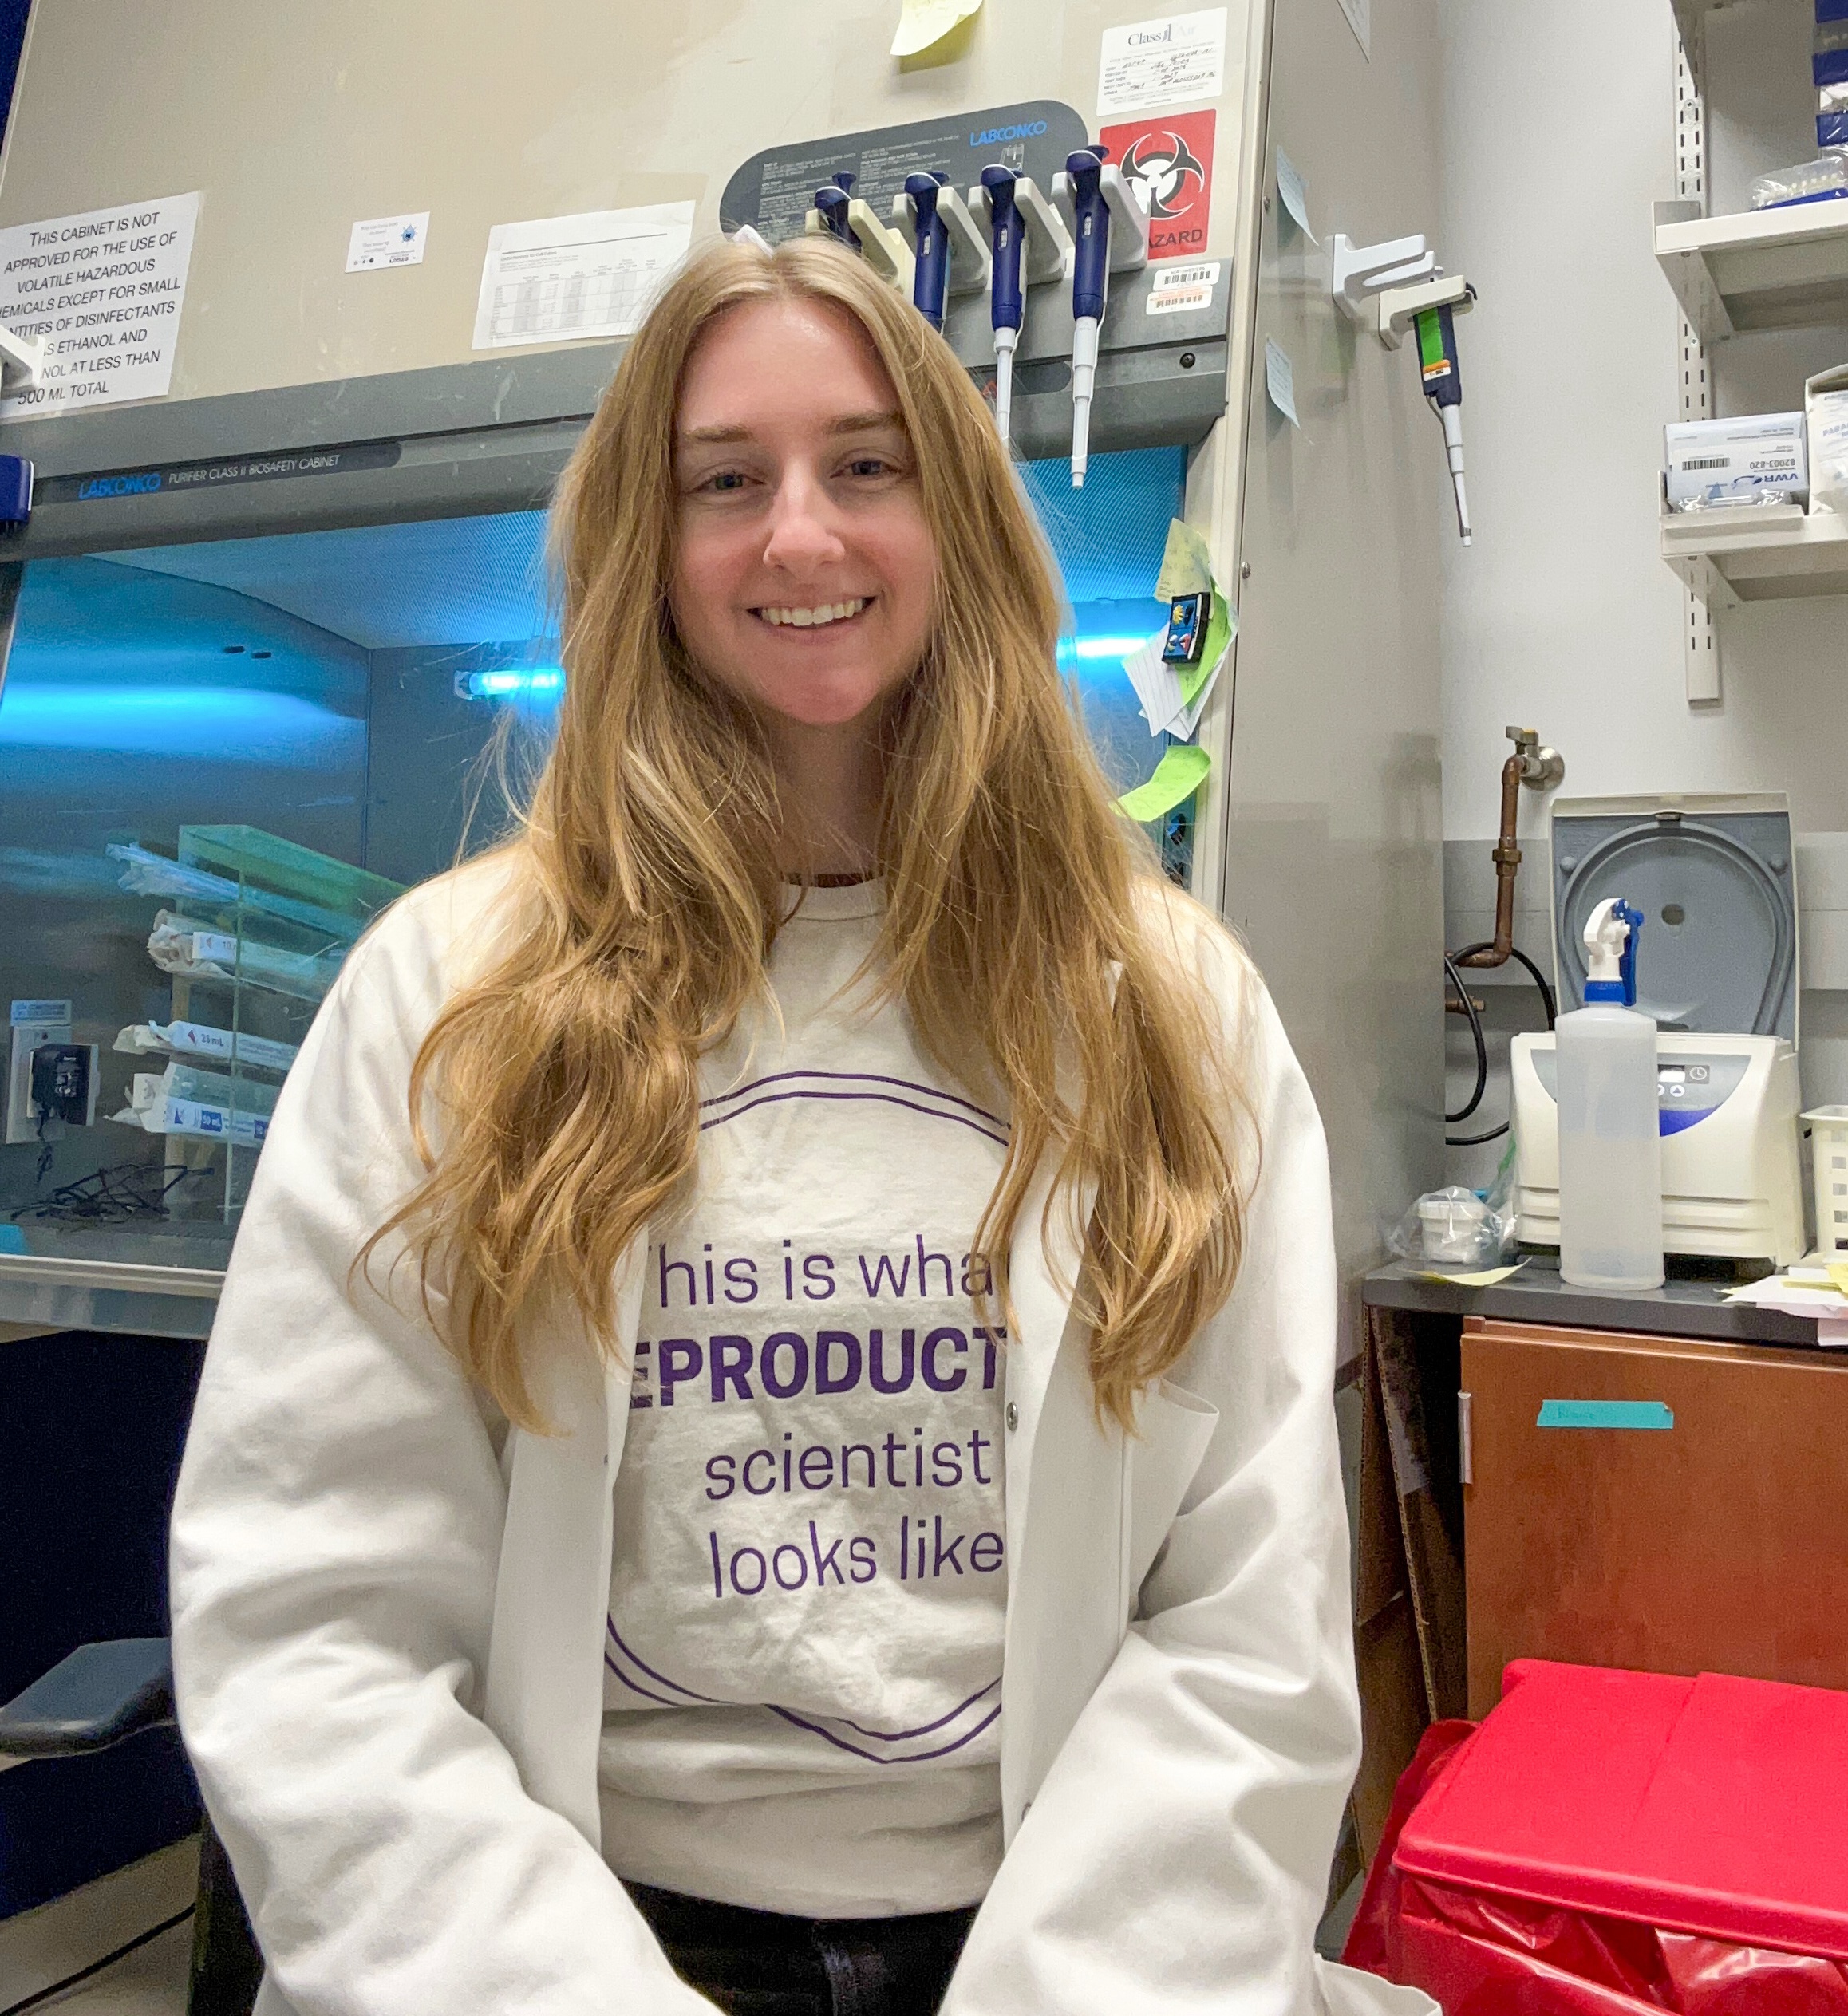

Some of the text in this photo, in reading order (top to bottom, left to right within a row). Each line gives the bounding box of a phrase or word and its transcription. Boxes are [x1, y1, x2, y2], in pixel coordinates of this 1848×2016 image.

[970, 120, 1048, 147] LABCONCO
[30, 212, 160, 247] THIS CABINET IS NOT
[4, 231, 177, 274] APPROVED FOR THE USE OF
[18, 258, 156, 293] VOLATILE HAZARDOUS
[58, 289, 106, 309] EXCEPT
[109, 285, 136, 300] FOR
[139, 278, 180, 296] SMALL
[56, 317, 73, 332] OF
[76, 301, 175, 326] DISINFECTANTS
[57, 333, 116, 353] ETHANOL
[120, 329, 148, 343] AND
[69, 361, 87, 374] AT
[89, 356, 121, 372] LESS
[126, 349, 160, 365] THAN
[49, 387, 65, 400] ML
[70, 381, 109, 397] TOTAL
[168, 454, 341, 484] PURIFIER CLASS II BIOSAFETY CABINET
[1764, 473, 1799, 482] VWR
[78, 472, 161, 500] LABCONCO
[657, 1234, 1010, 1308] his is wha
[705, 1427, 991, 1501] scientist
[709, 1515, 1004, 1598] looks like
